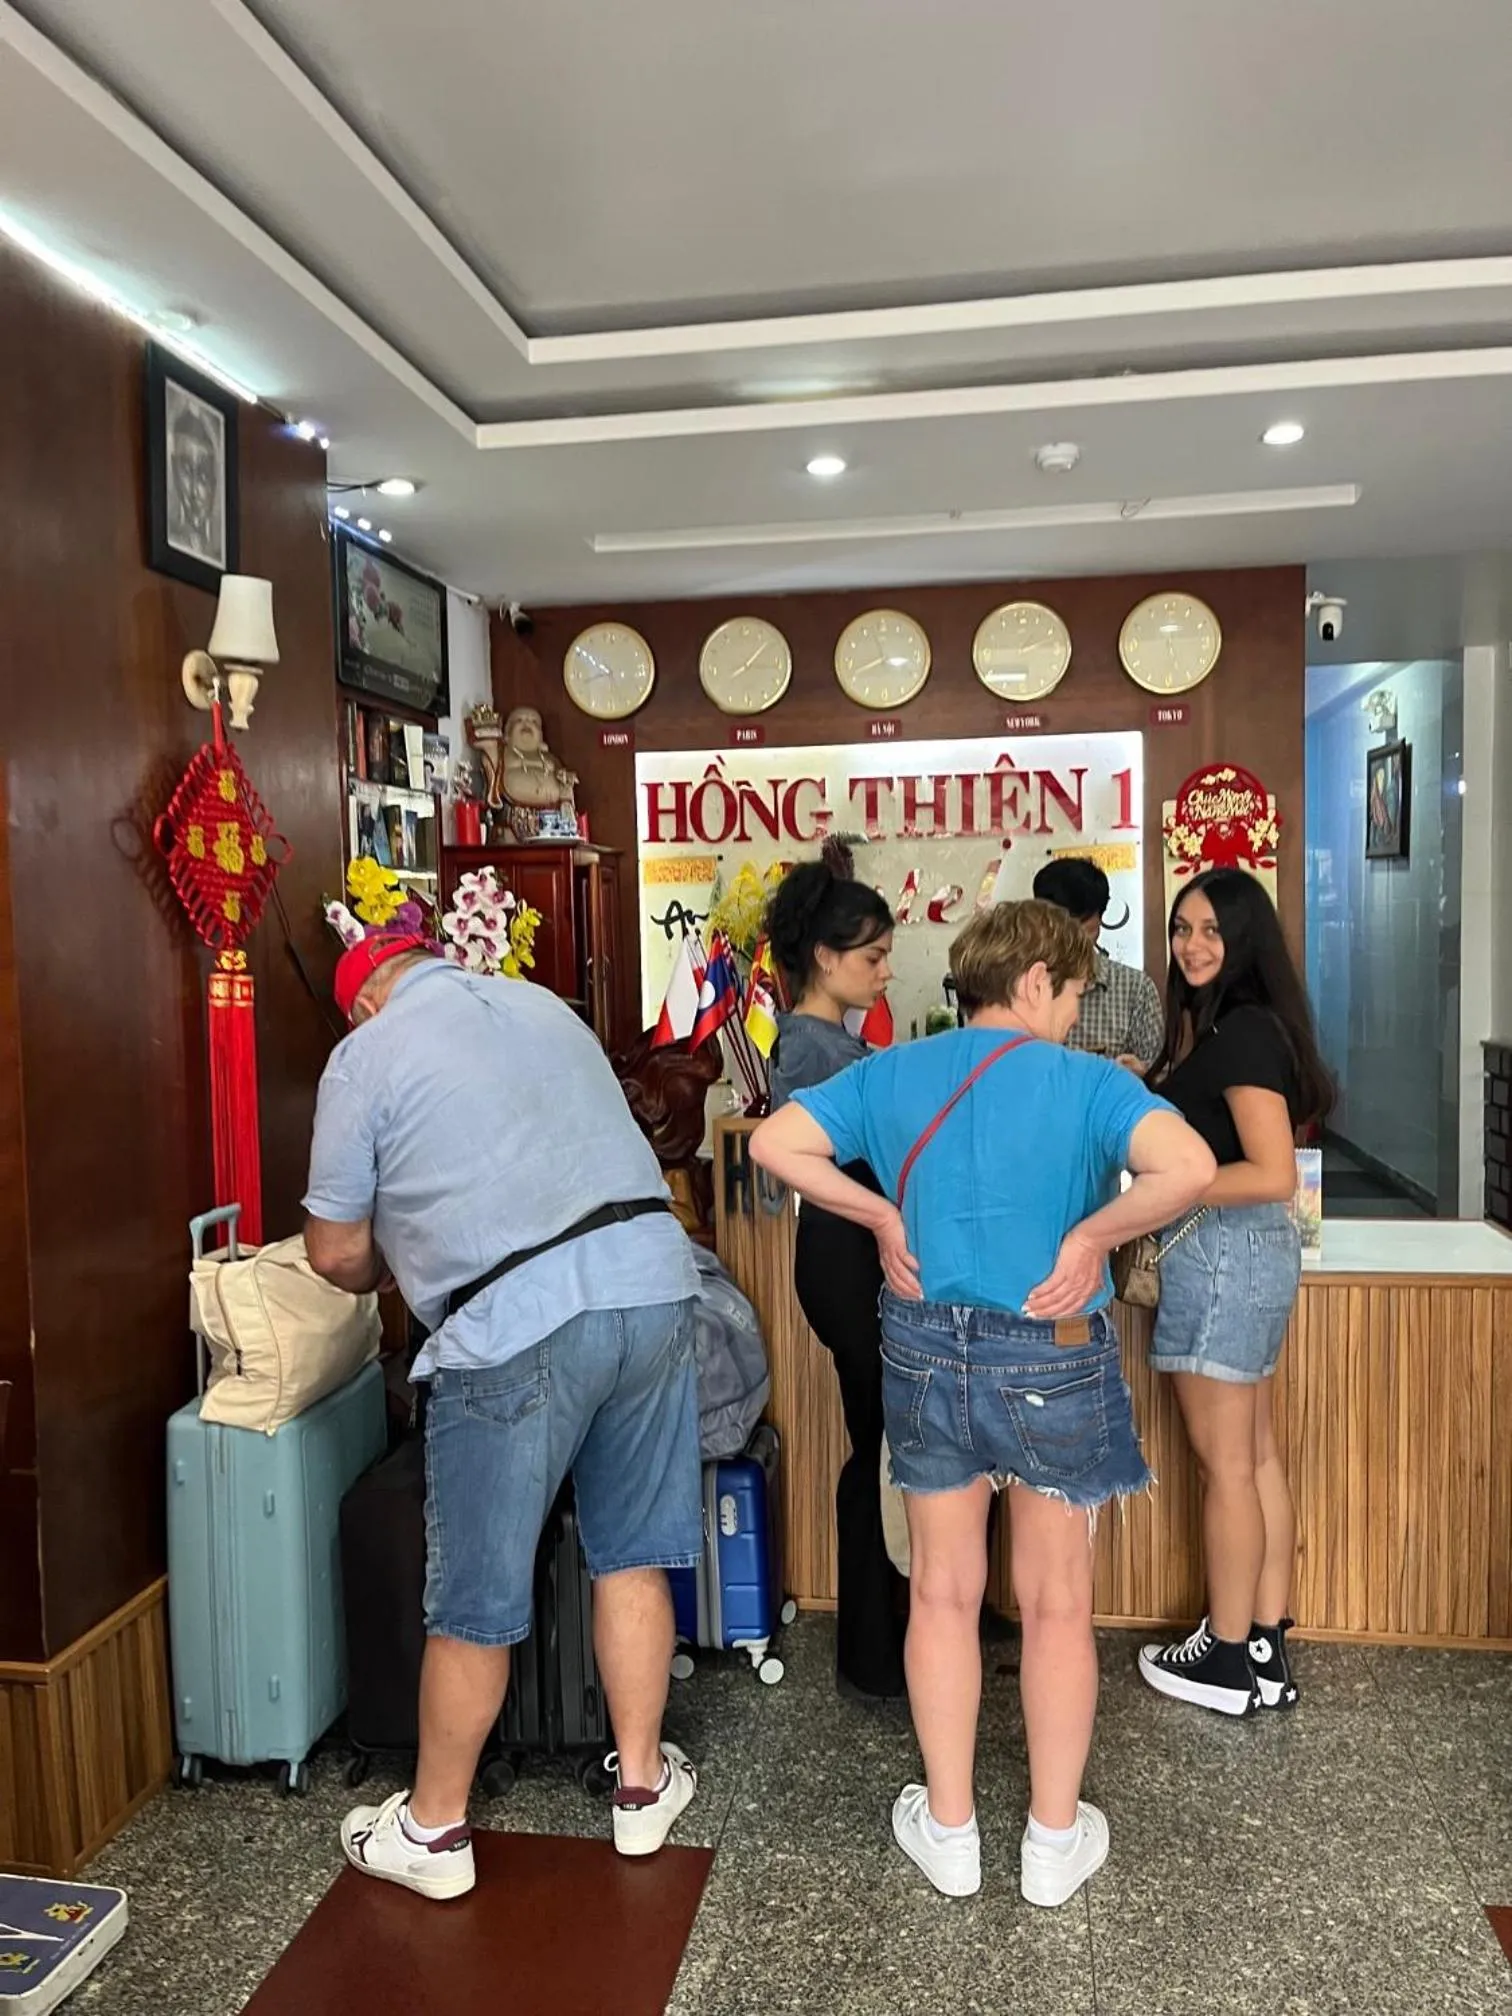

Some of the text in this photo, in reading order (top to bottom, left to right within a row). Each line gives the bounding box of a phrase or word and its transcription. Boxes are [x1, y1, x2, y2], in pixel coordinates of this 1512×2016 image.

[1158, 709, 1183, 721] TOKYO
[603, 734, 629, 746] LONDON
[736, 729, 758, 742] PARIS
[641, 755, 833, 844] HỒNG
[1111, 768, 1140, 829] 1
